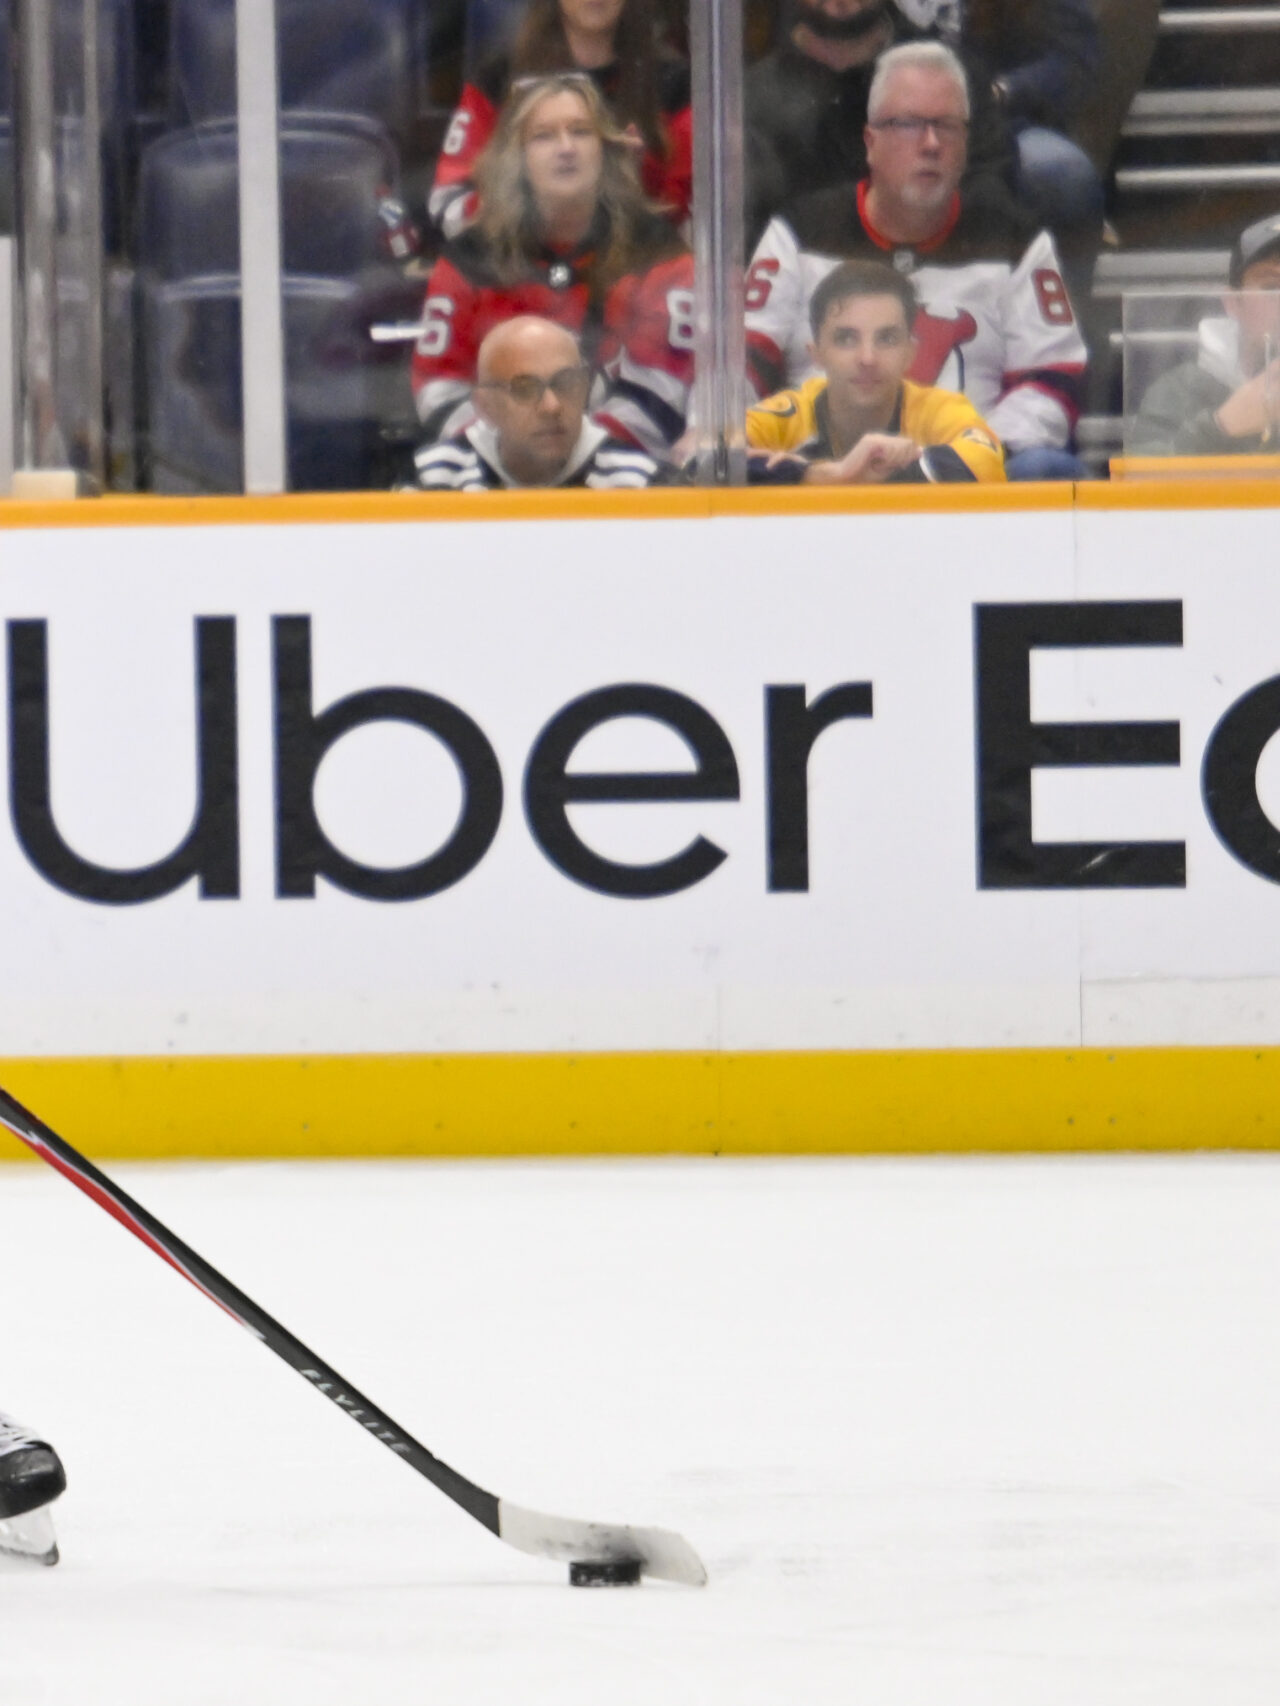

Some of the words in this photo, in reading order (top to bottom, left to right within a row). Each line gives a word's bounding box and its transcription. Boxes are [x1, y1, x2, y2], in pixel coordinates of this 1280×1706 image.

[443, 109, 471, 155] 6
[417, 296, 454, 357] 6
[1032, 268, 1073, 325] 8
[7, 615, 873, 905] Uber
[300, 1368, 412, 1453] FLYLITE
